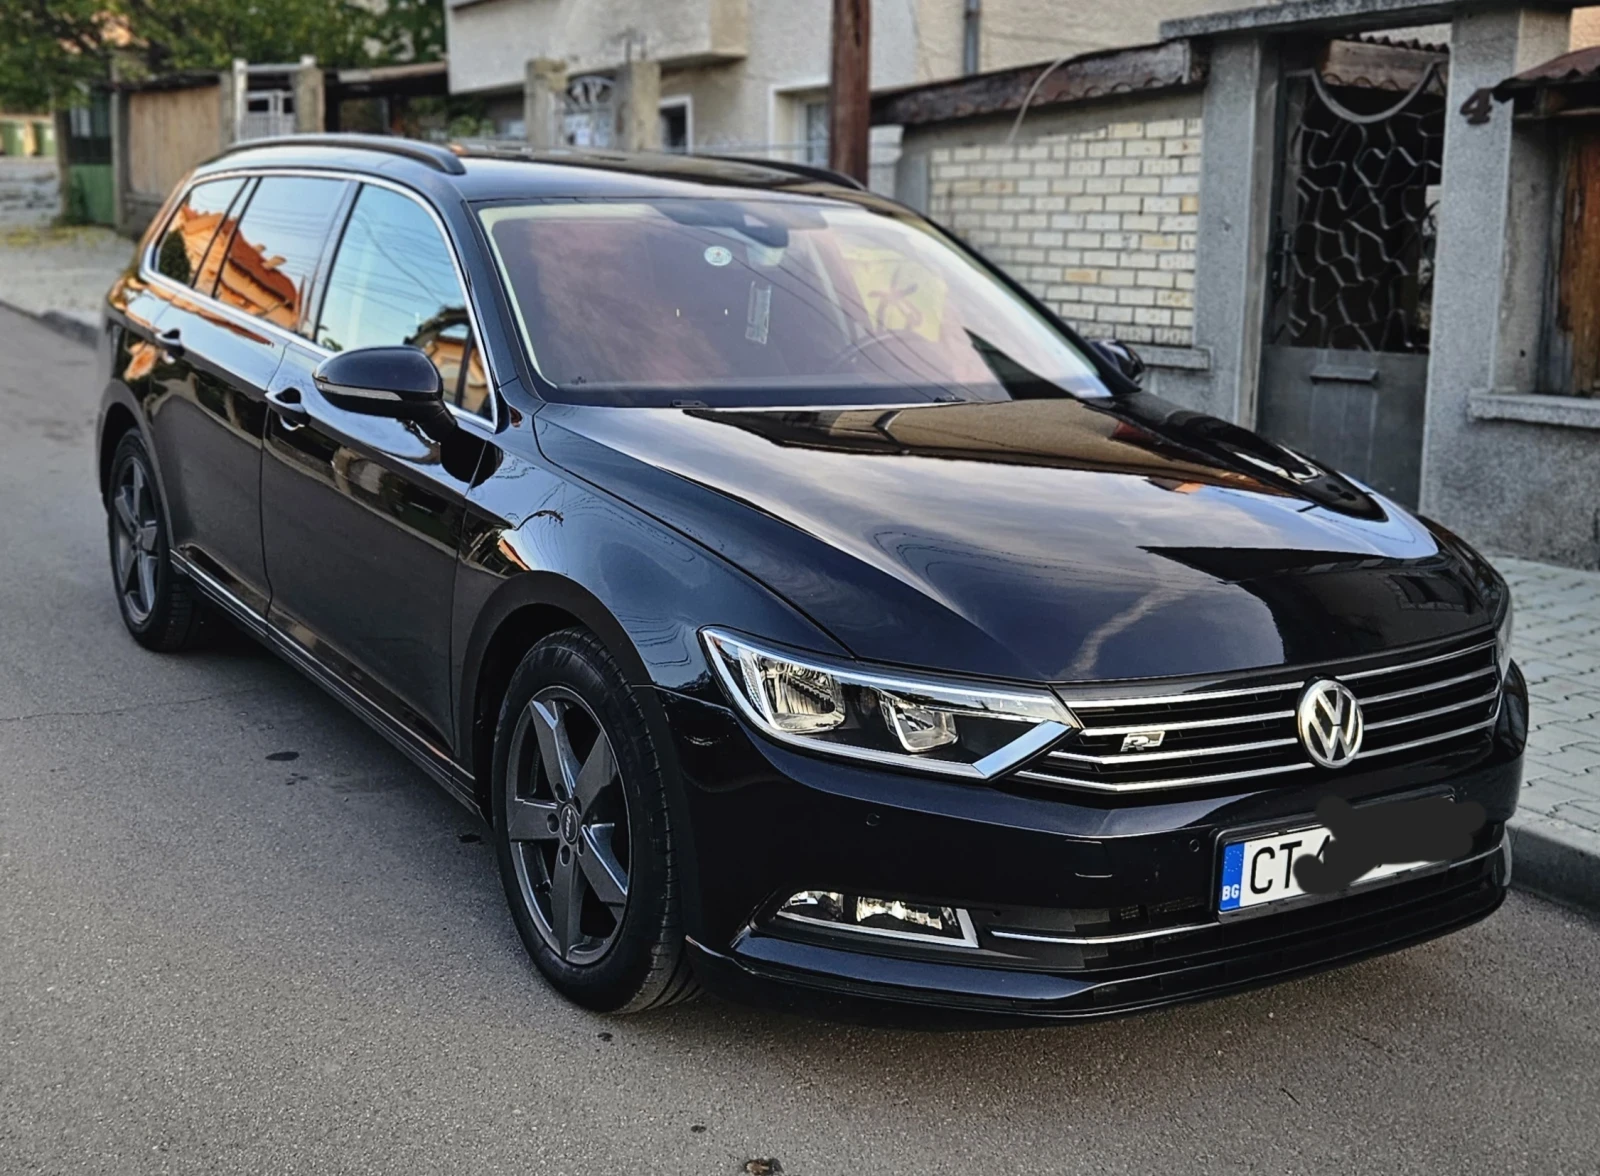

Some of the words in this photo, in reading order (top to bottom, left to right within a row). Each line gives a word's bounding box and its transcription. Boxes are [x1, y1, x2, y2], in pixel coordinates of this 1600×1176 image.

[1460, 88, 1493, 125] 4
[1120, 734, 1152, 752] R
[1303, 684, 1360, 765] VW
[1250, 840, 1303, 895] CT
[1221, 883, 1240, 901] BG
